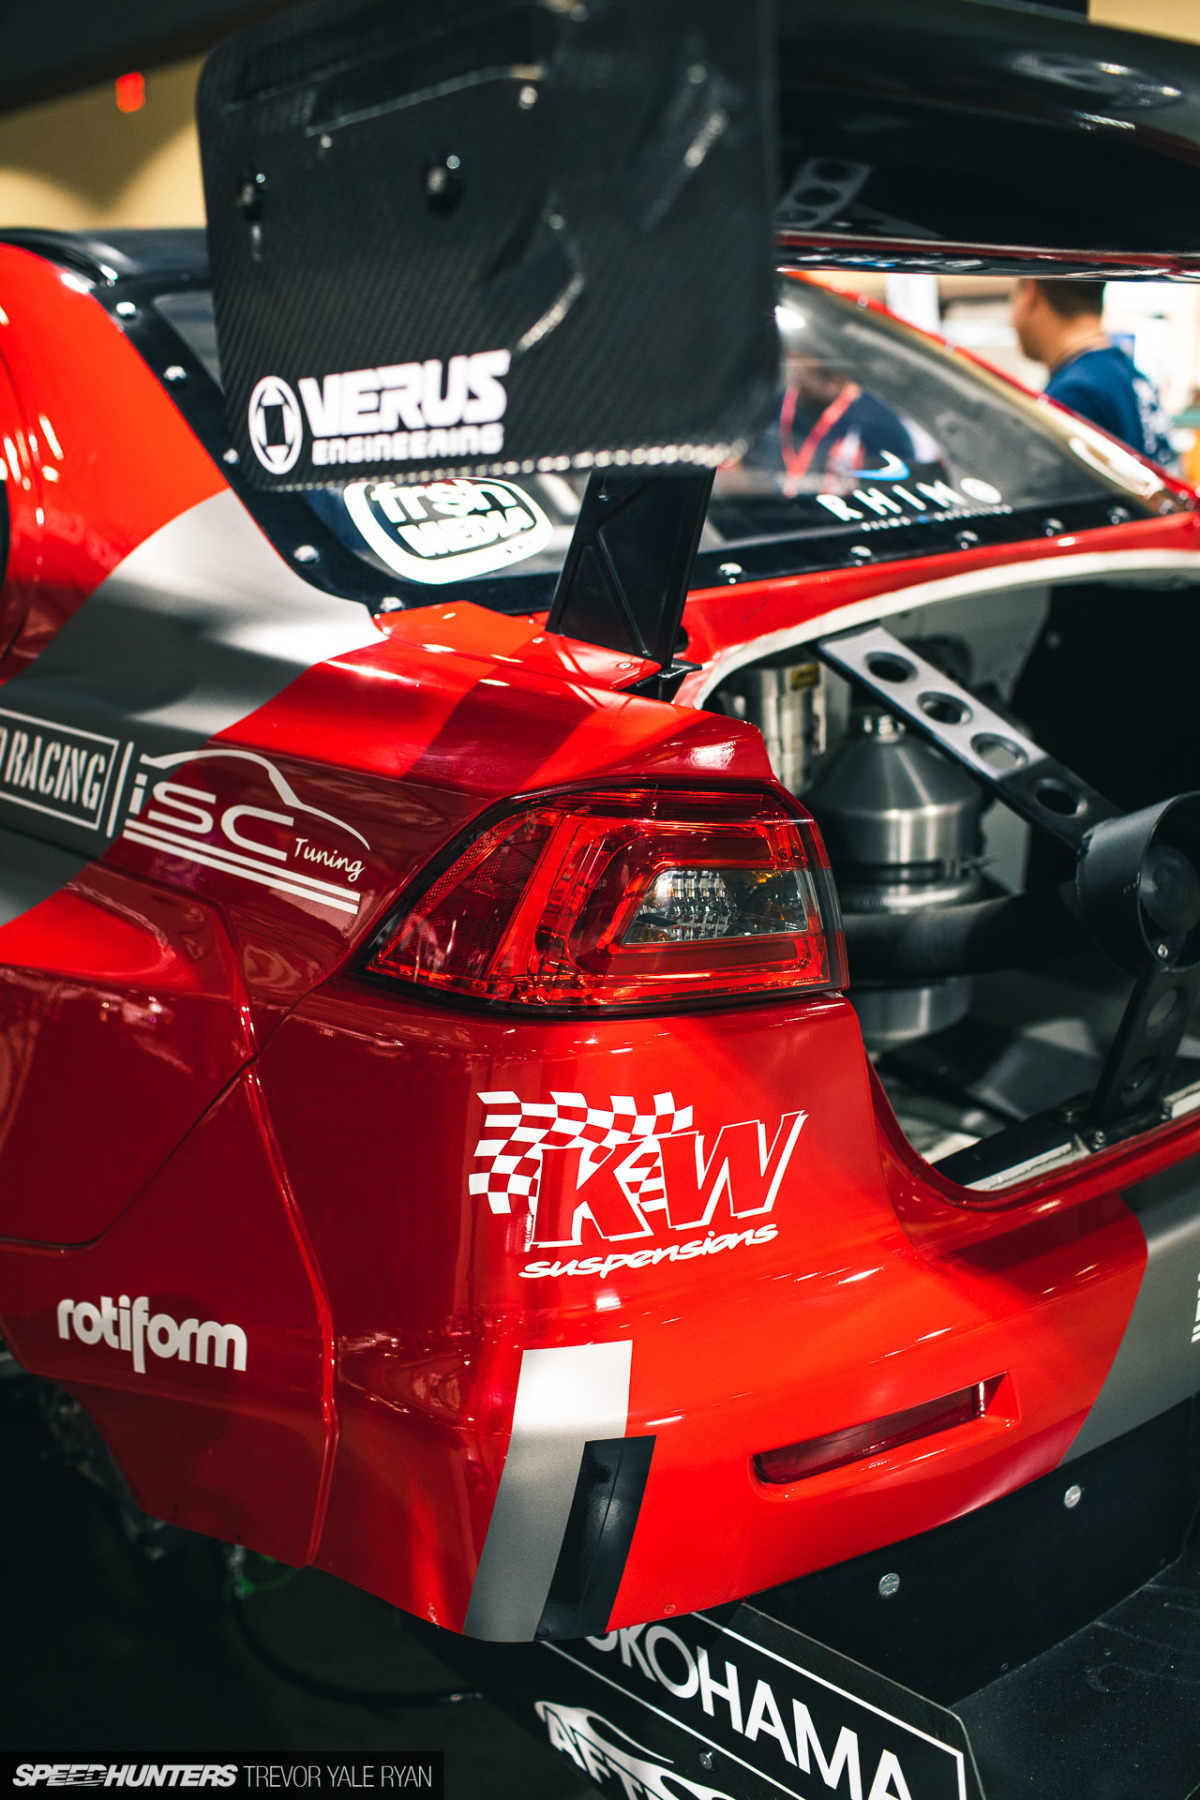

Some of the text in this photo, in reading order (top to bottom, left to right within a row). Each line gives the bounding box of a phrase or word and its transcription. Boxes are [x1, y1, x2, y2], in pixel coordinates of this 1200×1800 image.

[298, 349, 511, 437] VERUS
[816, 477, 1001, 521] RHINO
[5, 730, 106, 811] RACING
[294, 837, 366, 882] Tuning
[530, 1109, 809, 1248] KW
[518, 1223, 779, 1279] suspensions
[57, 1294, 248, 1374] rotiform
